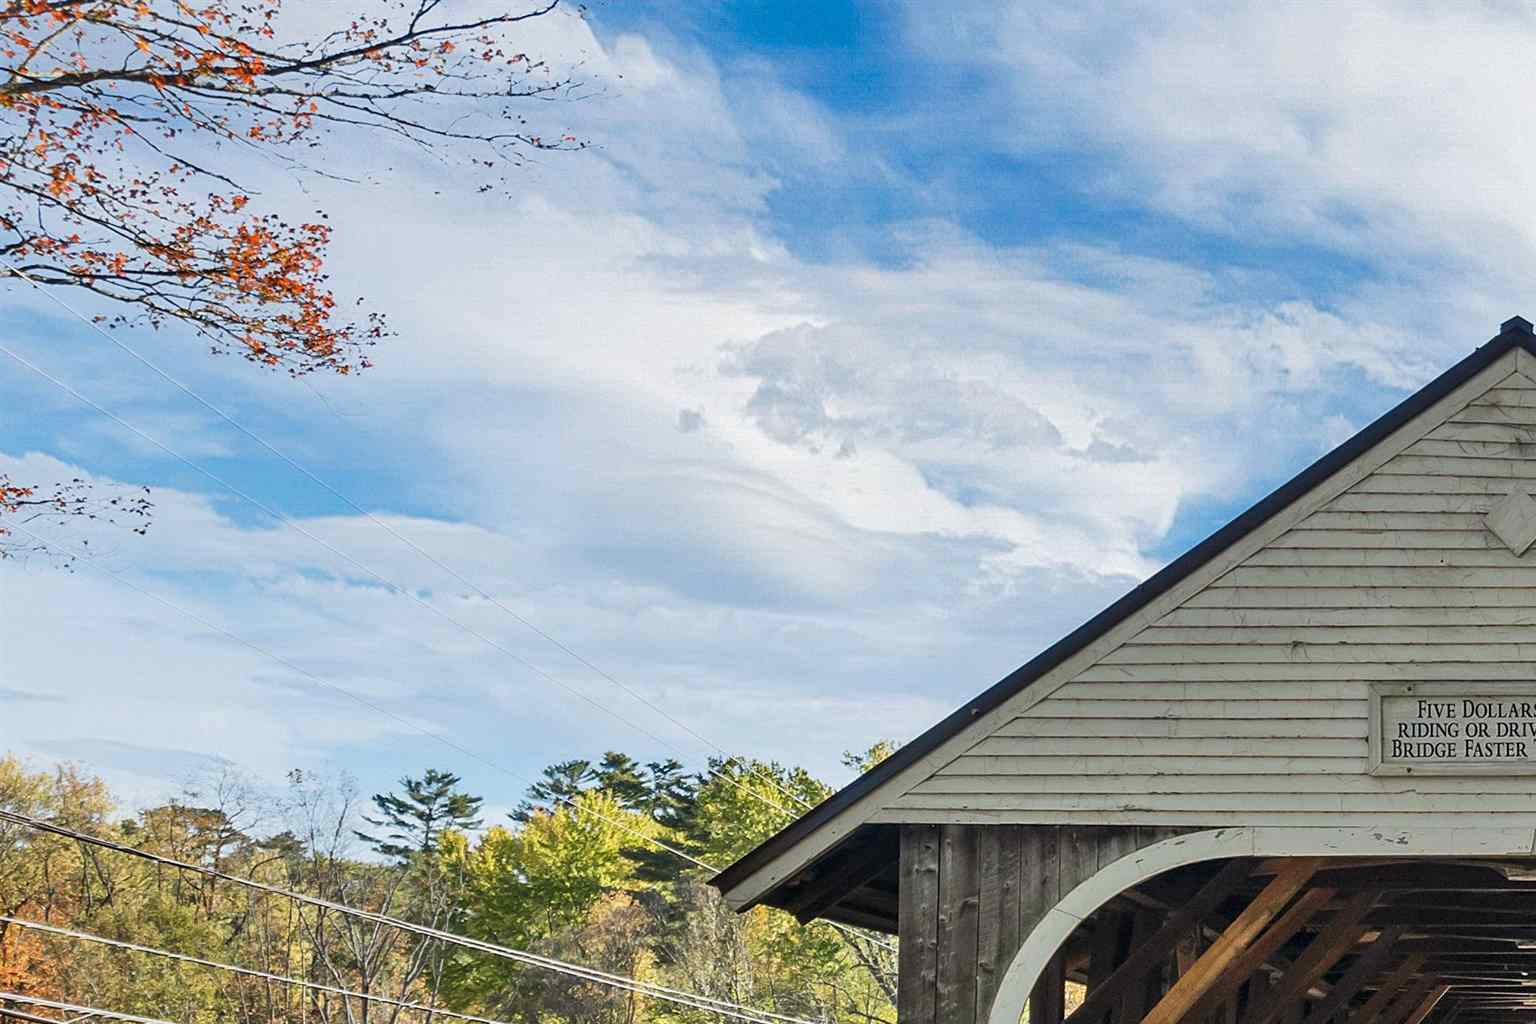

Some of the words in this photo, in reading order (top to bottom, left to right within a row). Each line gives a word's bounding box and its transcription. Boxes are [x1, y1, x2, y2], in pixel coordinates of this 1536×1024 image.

[1417, 699, 1457, 719] FIVE
[1398, 721, 1460, 739] RIDING
[1465, 721, 1491, 738] OR
[1391, 738, 1457, 759] BRIDGE
[1464, 738, 1529, 758] FASTER
